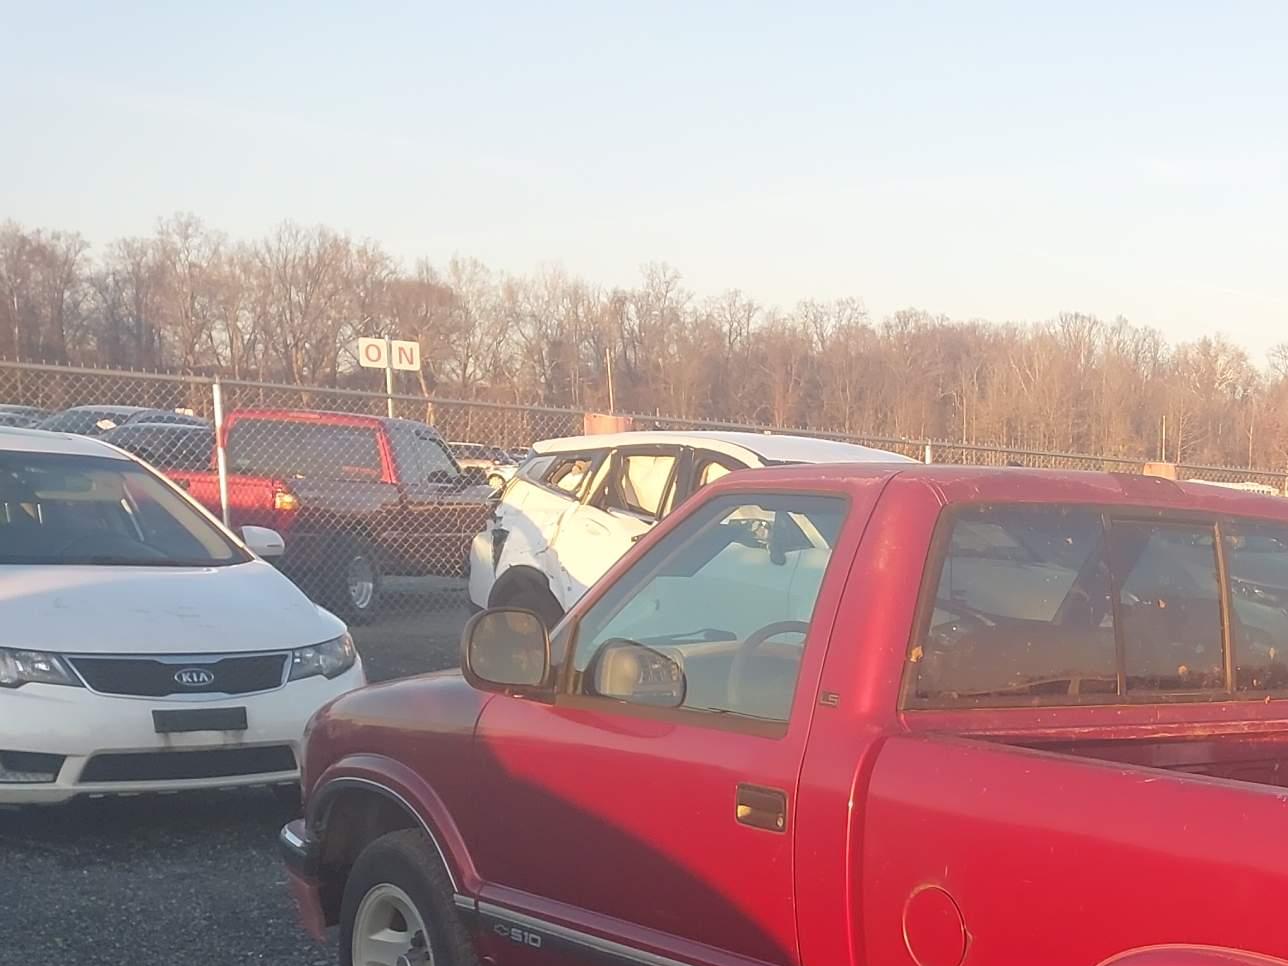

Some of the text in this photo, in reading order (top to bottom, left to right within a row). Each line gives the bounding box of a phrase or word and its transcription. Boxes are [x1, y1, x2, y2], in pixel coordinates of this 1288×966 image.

[365, 343, 414, 365] O N
[181, 671, 209, 683] KIA
[511, 928, 541, 948] S10
